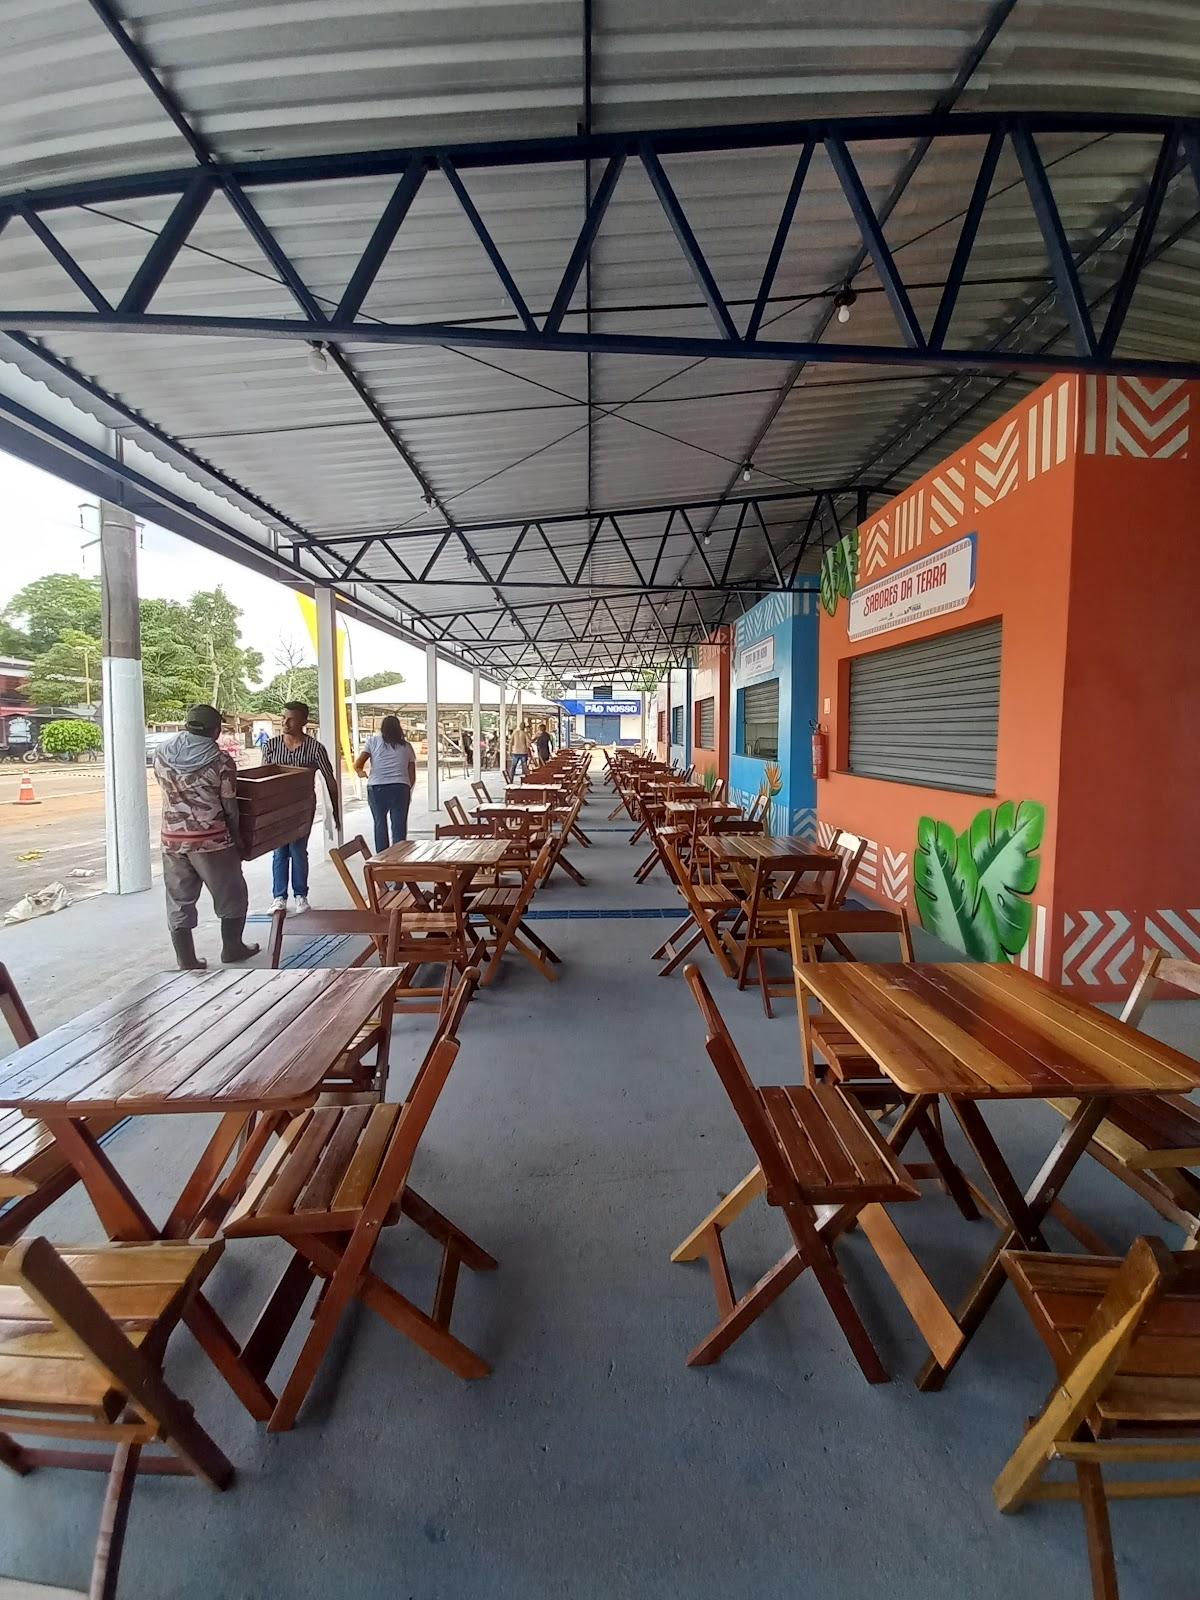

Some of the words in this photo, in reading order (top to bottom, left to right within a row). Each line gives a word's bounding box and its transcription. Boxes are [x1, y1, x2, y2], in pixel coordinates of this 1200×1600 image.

[863, 583, 898, 617] SABORES
[900, 577, 913, 601] DA
[916, 562, 947, 594] TERRA
[585, 704, 604, 713] PÃO
[606, 705, 637, 713] NOSSO
